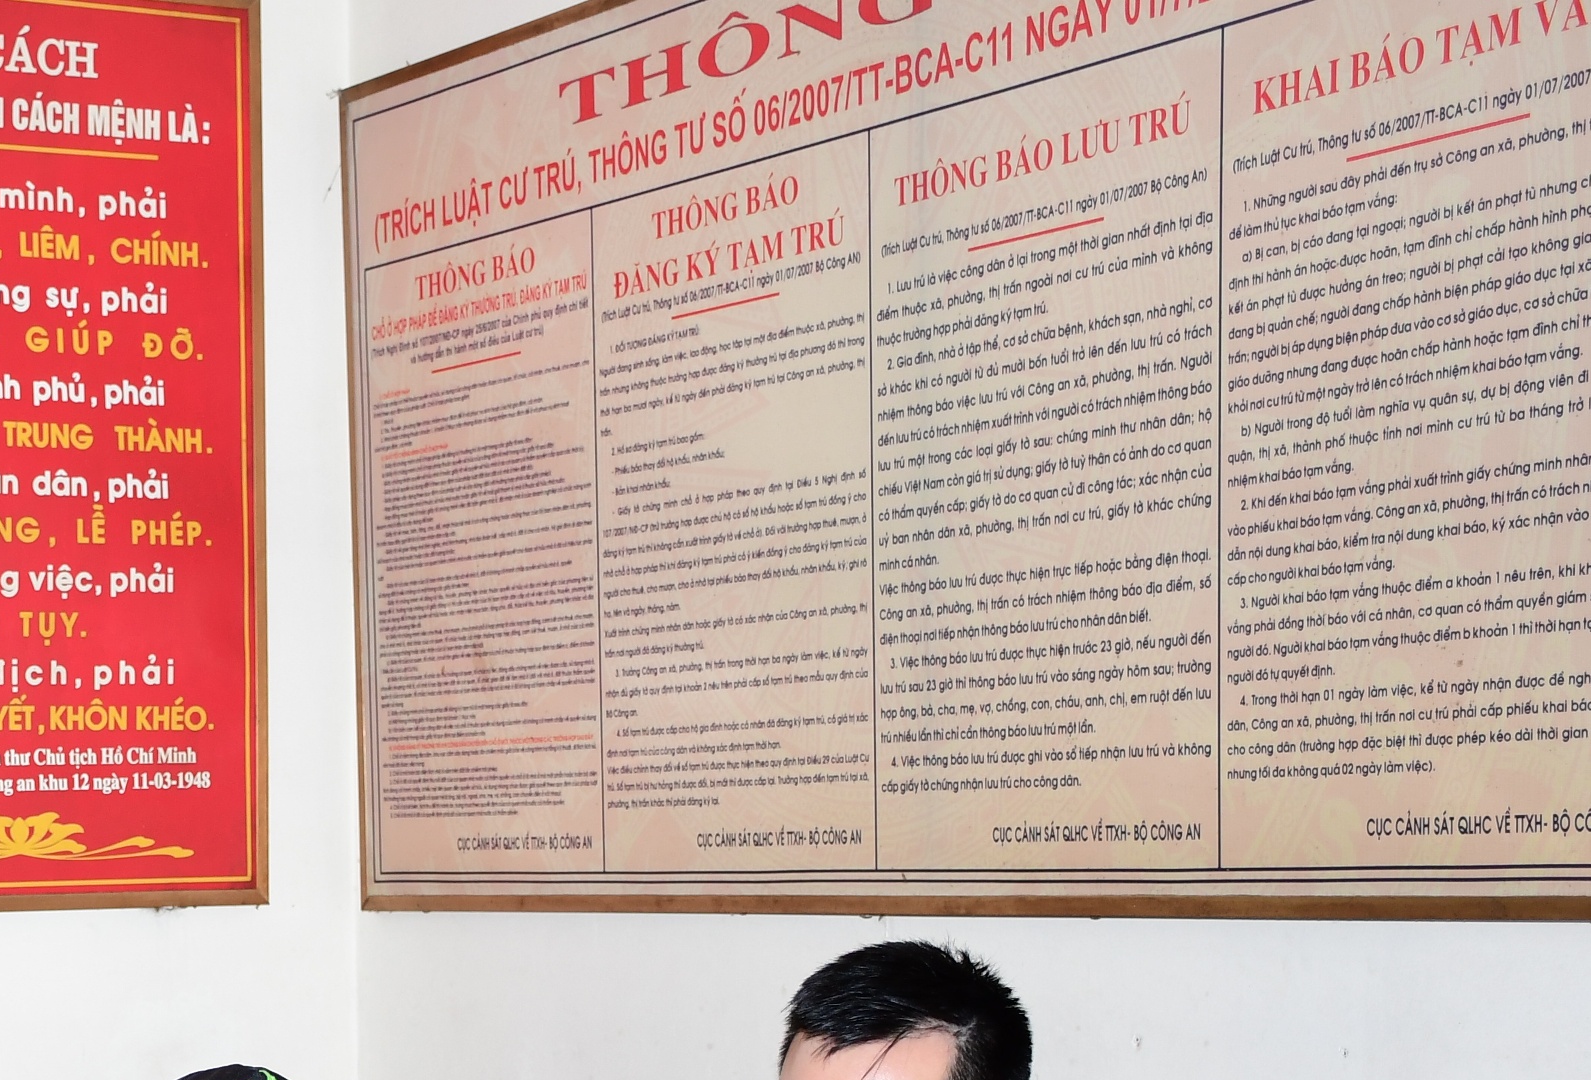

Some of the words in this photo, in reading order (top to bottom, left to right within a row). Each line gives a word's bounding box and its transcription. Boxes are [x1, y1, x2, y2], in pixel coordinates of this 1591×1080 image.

[1252, 57, 1340, 115] KHAI
[1348, 33, 1425, 90] BÁO
[1436, 7, 1522, 66] TẠM
[12, 91, 80, 135] CÁCH
[87, 98, 161, 146] MỆNH
[374, 197, 437, 251] (TRÍCH
[441, 176, 493, 228] LUẬT
[498, 165, 530, 211] CƯ
[533, 148, 582, 200] TRÚ,
[588, 128, 668, 184] THÔNG
[674, 111, 707, 159] TƯ
[712, 87, 746, 149] SỐ
[754, 21, 1012, 137] 06/2007/TT-BCA-C11
[894, 156, 988, 207] THÔNG
[995, 134, 1054, 183] BÁO
[1061, 118, 1120, 166] LƯU
[1128, 91, 1191, 147] TRÚ
[98, 186, 167, 221] phải
[652, 191, 738, 240] THÔNG
[745, 173, 799, 217] BÁO
[1099, 180, 1148, 206] 01/07/2007
[111, 231, 208, 268] CHÍNH.
[613, 256, 679, 300] ĐĂNG
[686, 247, 720, 284] KÝ
[727, 229, 784, 274] TẠM
[791, 214, 845, 257] TRÚ
[416, 258, 486, 302] THÔNG
[491, 243, 536, 283] BÁO
[101, 281, 167, 317] phải
[26, 320, 113, 355] GIÚP
[142, 327, 203, 360] ĐỠ.
[104, 375, 165, 410] phải
[3, 421, 94, 450] TRUNG
[115, 418, 212, 453] THÀNH.
[108, 468, 169, 504] phải
[132, 512, 214, 547] PHÉP.
[28, 564, 102, 600] việc,
[110, 562, 174, 598] phải
[20, 611, 86, 645] TỤY.
[93, 653, 174, 691] phải
[50, 698, 127, 731] KHÔN
[136, 697, 214, 731] KHÉO.
[3, 748, 31, 767] thư
[33, 746, 66, 766] Chủ
[68, 747, 98, 770] tịch
[100, 745, 124, 765] Hồ
[126, 747, 154, 765] Chí
[157, 746, 197, 764] Minh
[16, 778, 36, 792] an
[38, 773, 69, 791] khu
[72, 773, 90, 791] 12
[92, 772, 129, 795] ngày
[132, 771, 211, 790] 11-03-1948
[992, 826, 1012, 847] CỤC
[1014, 820, 1041, 843] CẢNH
[1043, 820, 1060, 843] SÁT
[1062, 824, 1088, 843] QLHC
[1090, 817, 1102, 842] VỀ
[1104, 824, 1130, 842] TTXH-
[1133, 819, 1147, 846] BỘ
[1150, 819, 1182, 842] CÔNG
[1185, 822, 1200, 841] AN
[1366, 817, 1392, 841] CỤC
[1395, 809, 1430, 836] CẢNH
[1433, 809, 1454, 836] SÁT
[1457, 815, 1491, 835] QLHC
[1495, 806, 1510, 834] VỀ
[1513, 813, 1547, 834] TTXH-
[1552, 808, 1570, 838] BỘ
